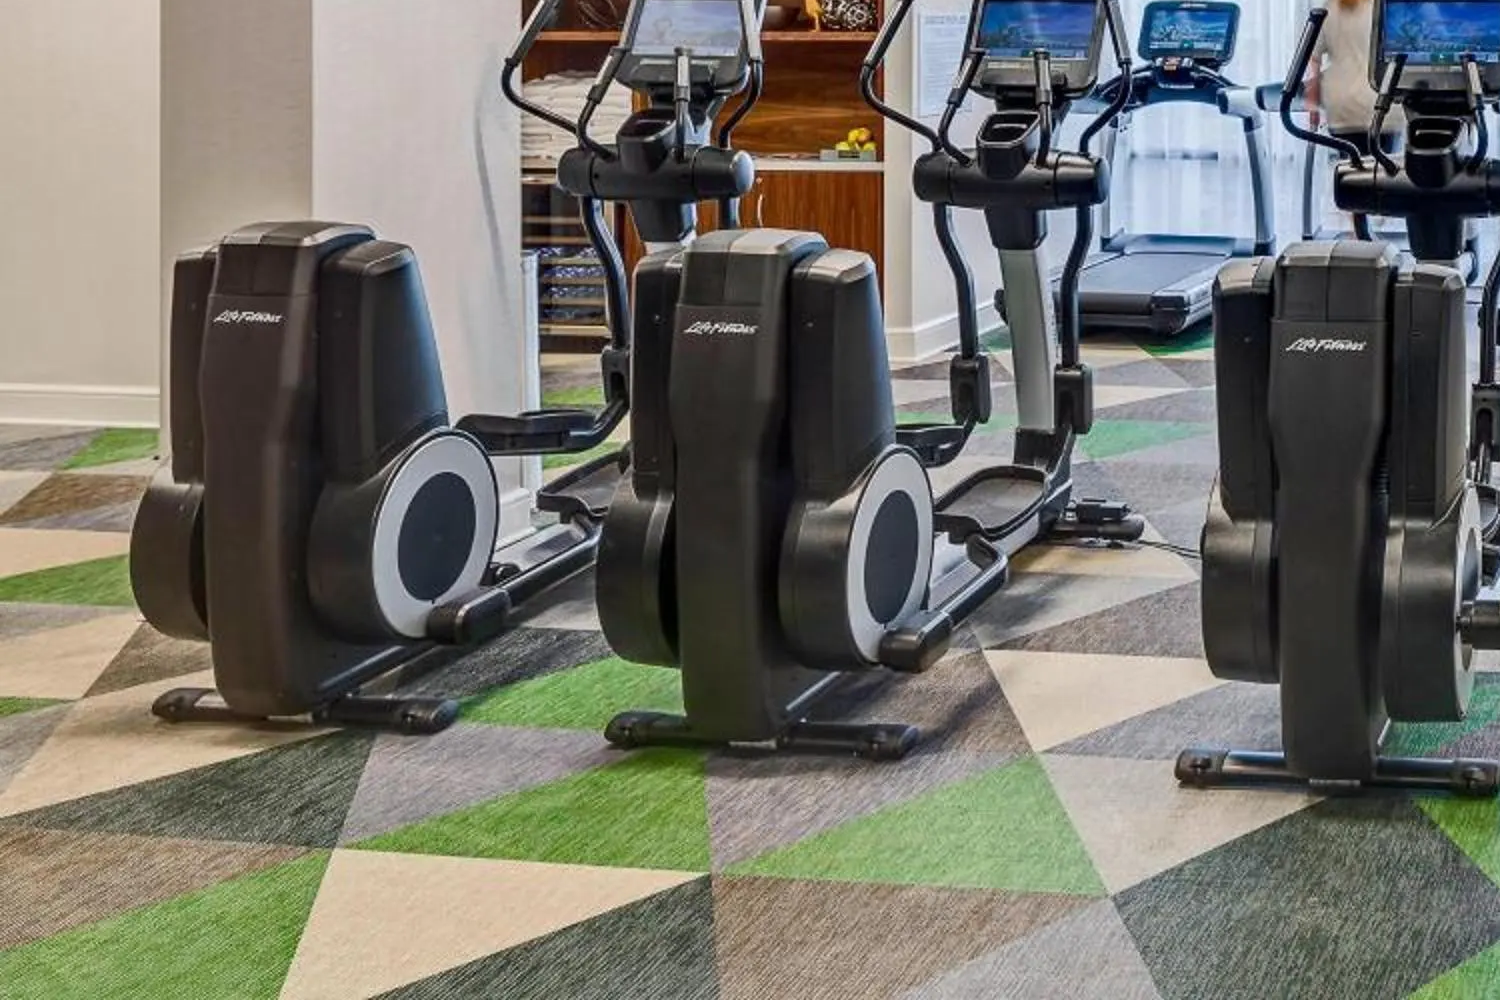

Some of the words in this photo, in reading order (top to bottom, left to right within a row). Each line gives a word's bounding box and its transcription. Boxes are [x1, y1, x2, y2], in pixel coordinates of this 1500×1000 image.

[236, 311, 282, 323] Fitness
[709, 321, 758, 335] Fitness
[1285, 337, 1316, 352] Life
[1313, 339, 1366, 352] Fitness
